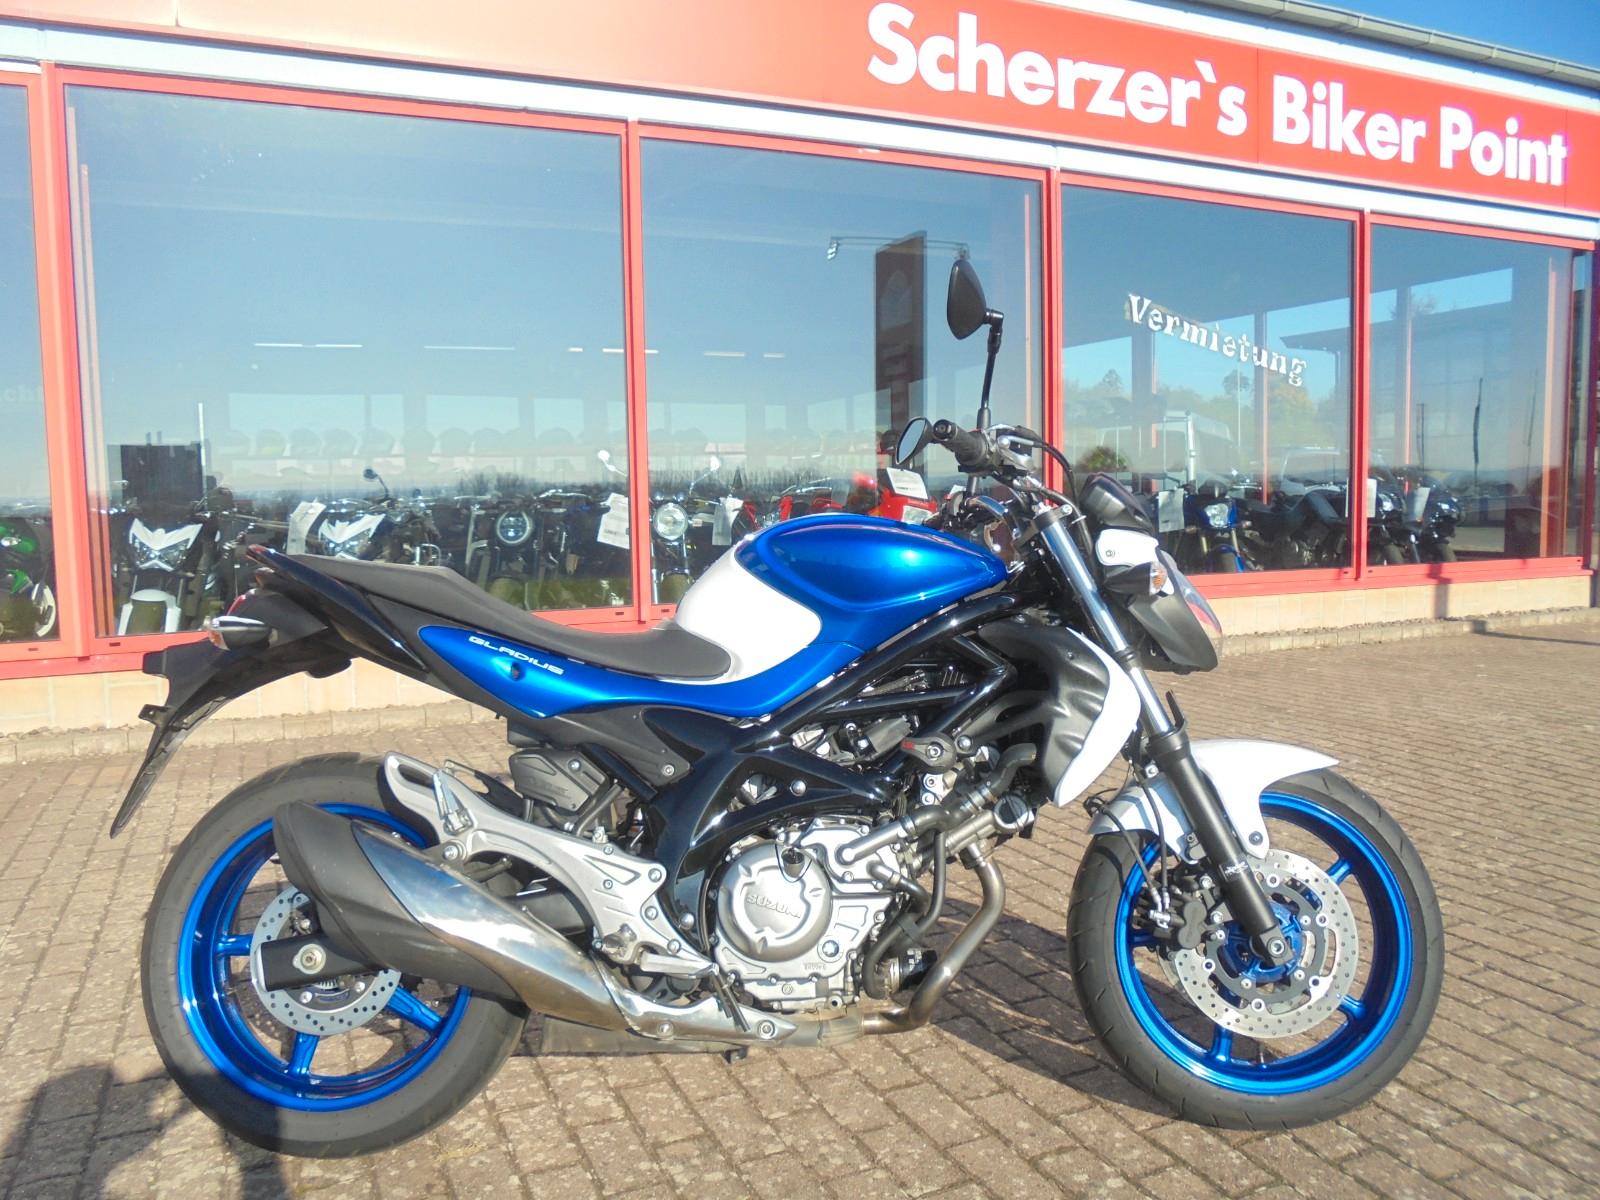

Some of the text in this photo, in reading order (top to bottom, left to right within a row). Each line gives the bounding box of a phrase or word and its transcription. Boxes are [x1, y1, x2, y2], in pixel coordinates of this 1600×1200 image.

[1272, 74, 1427, 164] Biker
[1439, 105, 1568, 186] Point
[1128, 293, 1307, 387] Vermietung
[468, 635, 564, 675] GLADIUS
